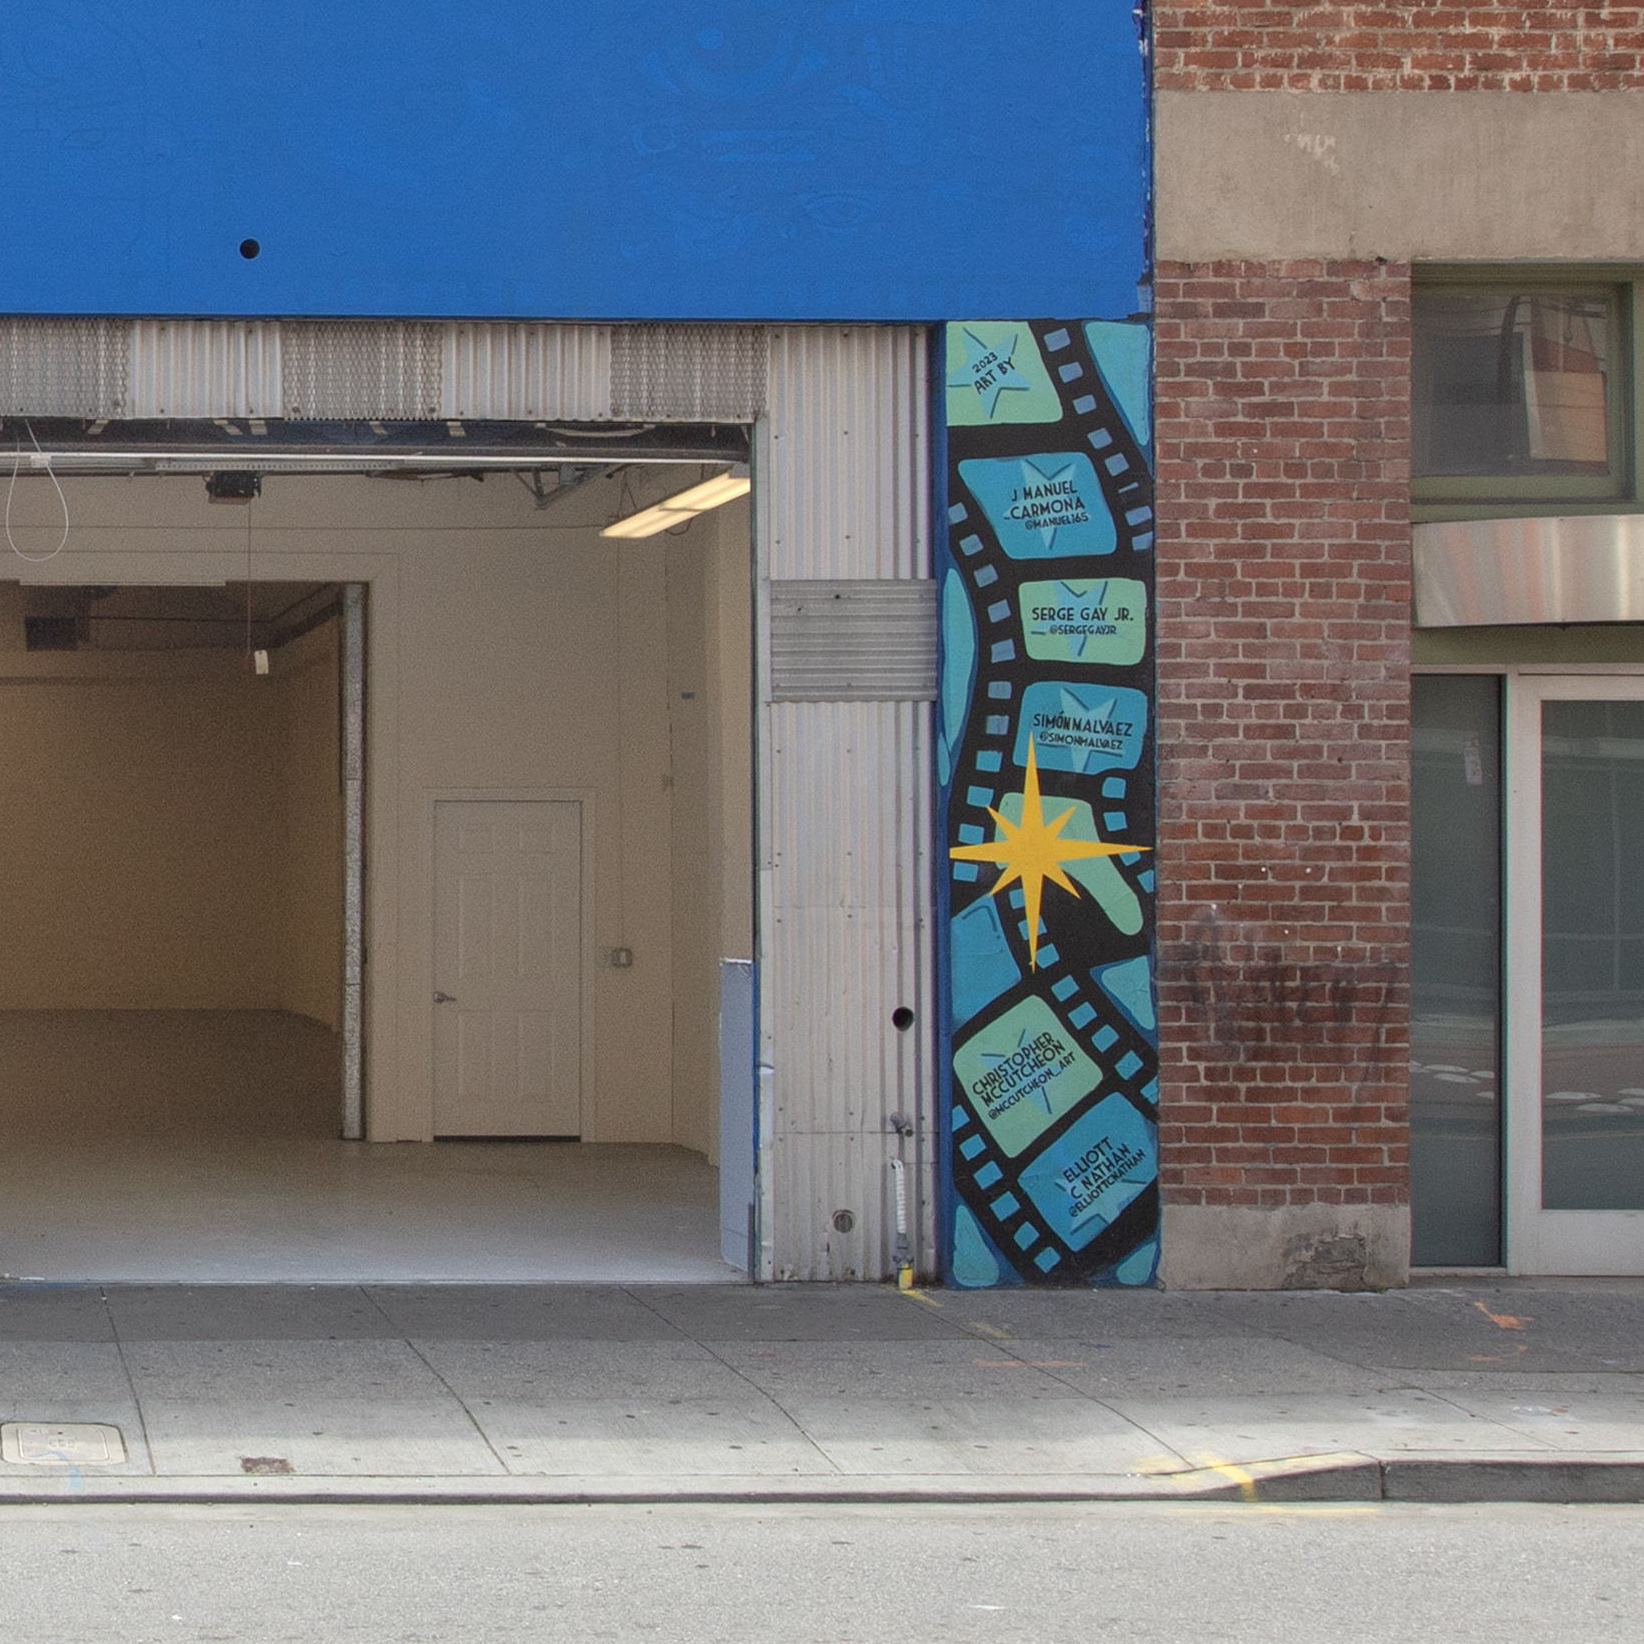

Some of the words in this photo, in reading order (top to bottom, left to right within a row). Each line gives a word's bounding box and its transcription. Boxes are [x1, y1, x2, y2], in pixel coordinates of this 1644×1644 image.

[972, 352, 998, 373] 2023
[974, 369, 997, 395] ART
[997, 356, 1015, 375] BY
[1012, 489, 1017, 502] J
[1023, 480, 1077, 500] MANUEL
[1010, 496, 1085, 520] CARMONA
[1025, 512, 1089, 531] @MANUEL165
[1031, 607, 1075, 621] SERGE
[1080, 607, 1108, 621] GAY
[1114, 607, 1134, 621] JR.
[1049, 625, 1117, 635] @SERGEGAYJR
[1033, 710, 1071, 730] SIMÓN
[1072, 717, 1133, 737] MALVAEZ
[1039, 731, 1123, 750] @SIMONMALVAEZ
[972, 1032, 1054, 1095] CHRISTOPHER
[980, 1039, 1066, 1107] MCCUTCHEON
[988, 1051, 1076, 1120] @MCCUTCHEON_ART
[1063, 1137, 1113, 1183] ELLIOTT
[1070, 1186, 1083, 1199] C
[1081, 1143, 1132, 1190] NATHAN
[1068, 1148, 1146, 1217] @ELLIOTTCNATHAN
